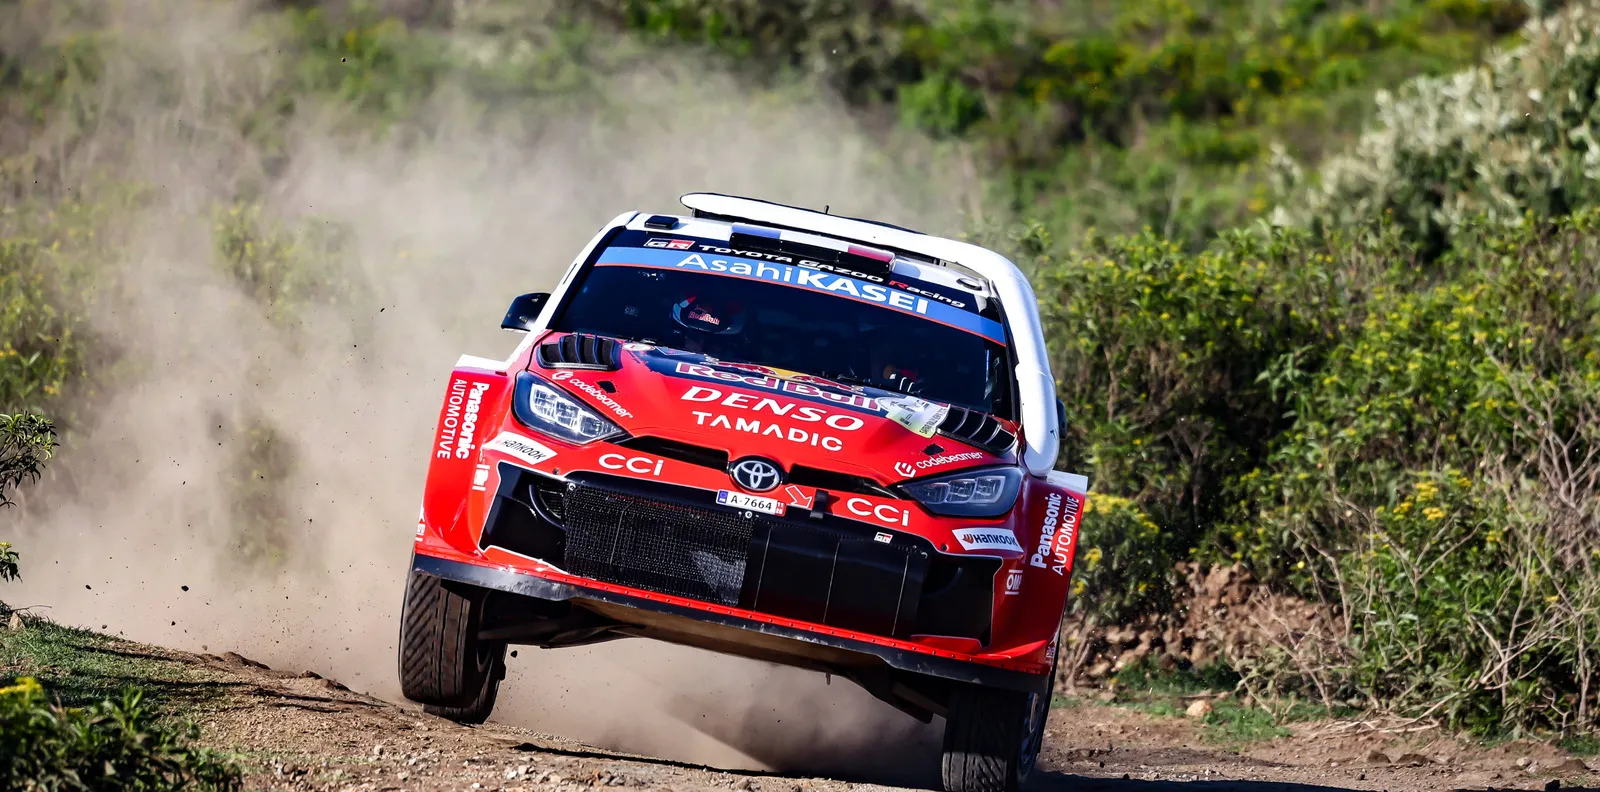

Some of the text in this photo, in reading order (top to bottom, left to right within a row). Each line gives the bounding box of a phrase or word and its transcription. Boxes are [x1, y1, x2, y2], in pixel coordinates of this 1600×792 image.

[699, 244, 793, 263] TOYOTA
[797, 259, 884, 282] GAZOO
[889, 280, 966, 308] Racing
[568, 376, 633, 419] codebeamer
[676, 361, 779, 390] Red
[782, 379, 881, 412] Bull
[681, 385, 865, 432] DENSO
[436, 378, 467, 460] AUTOMOTIVE
[456, 381, 490, 460] Panasonic
[692, 410, 844, 452] TAMADIC
[915, 450, 983, 469] codebeamer
[730, 495, 772, 511] A-7664
[1029, 492, 1063, 569] Panasonic
[1051, 497, 1080, 576] AUTOMOTIVE
